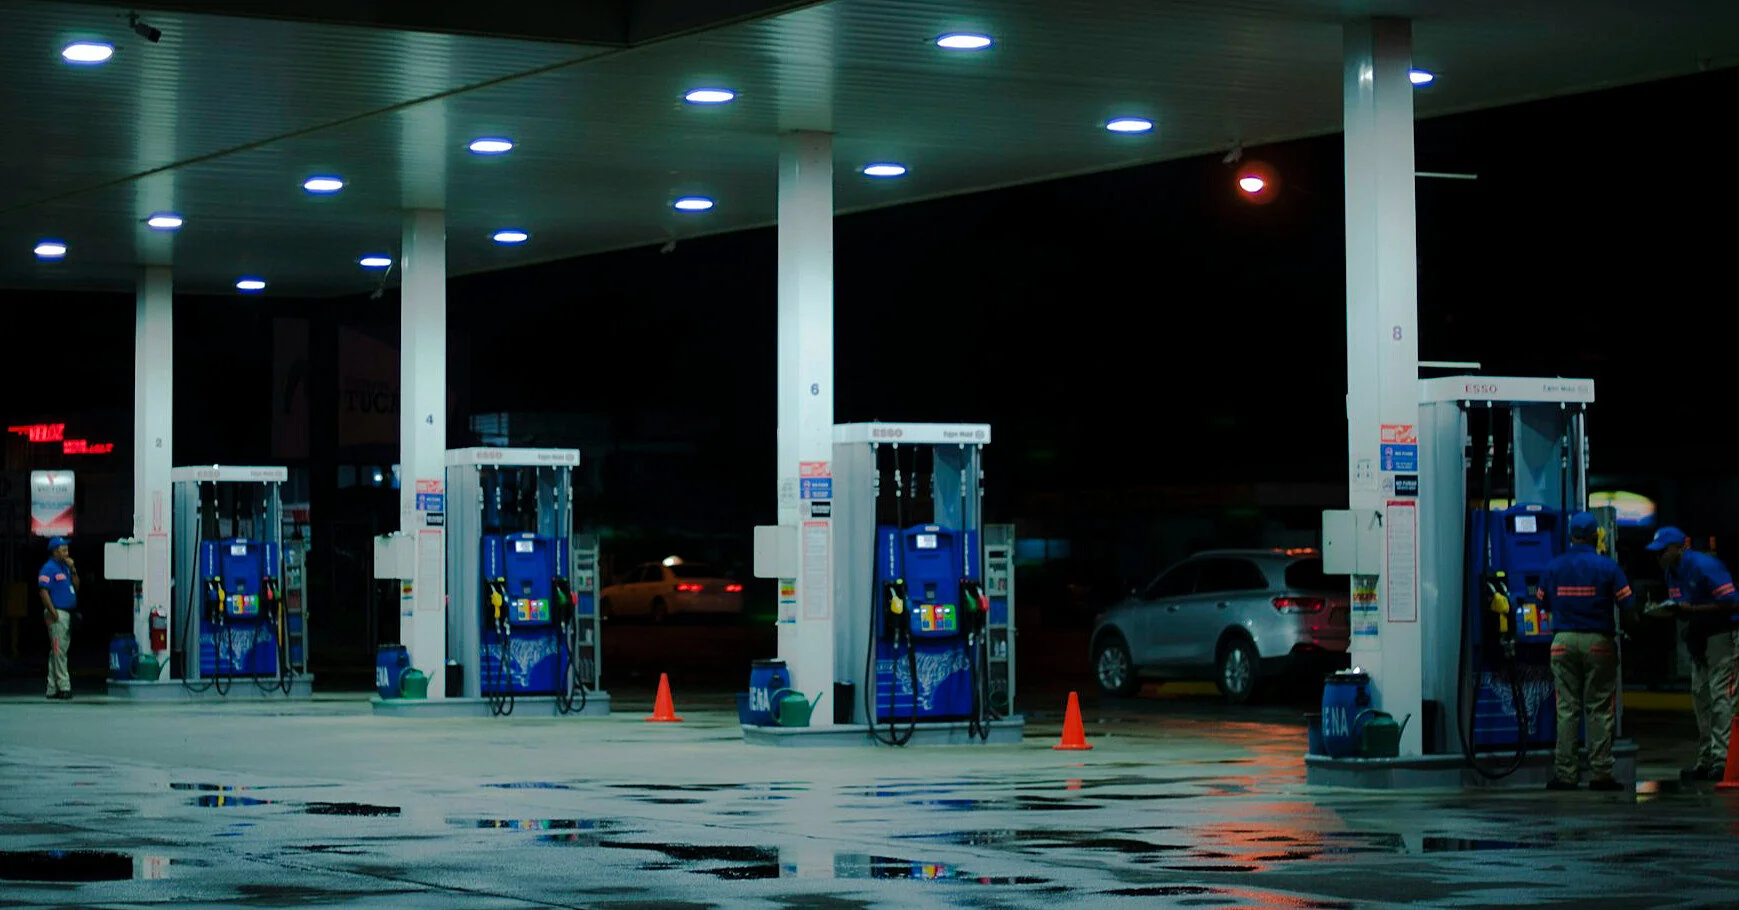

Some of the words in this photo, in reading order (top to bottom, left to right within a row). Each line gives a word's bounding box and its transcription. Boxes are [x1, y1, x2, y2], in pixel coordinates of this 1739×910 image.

[1393, 326, 1403, 341] 8
[810, 383, 819, 396] 6
[1465, 383, 1497, 394] ESSO
[425, 414, 434, 426] 4
[872, 428, 904, 438] ESSO
[155, 438, 163, 447] 2
